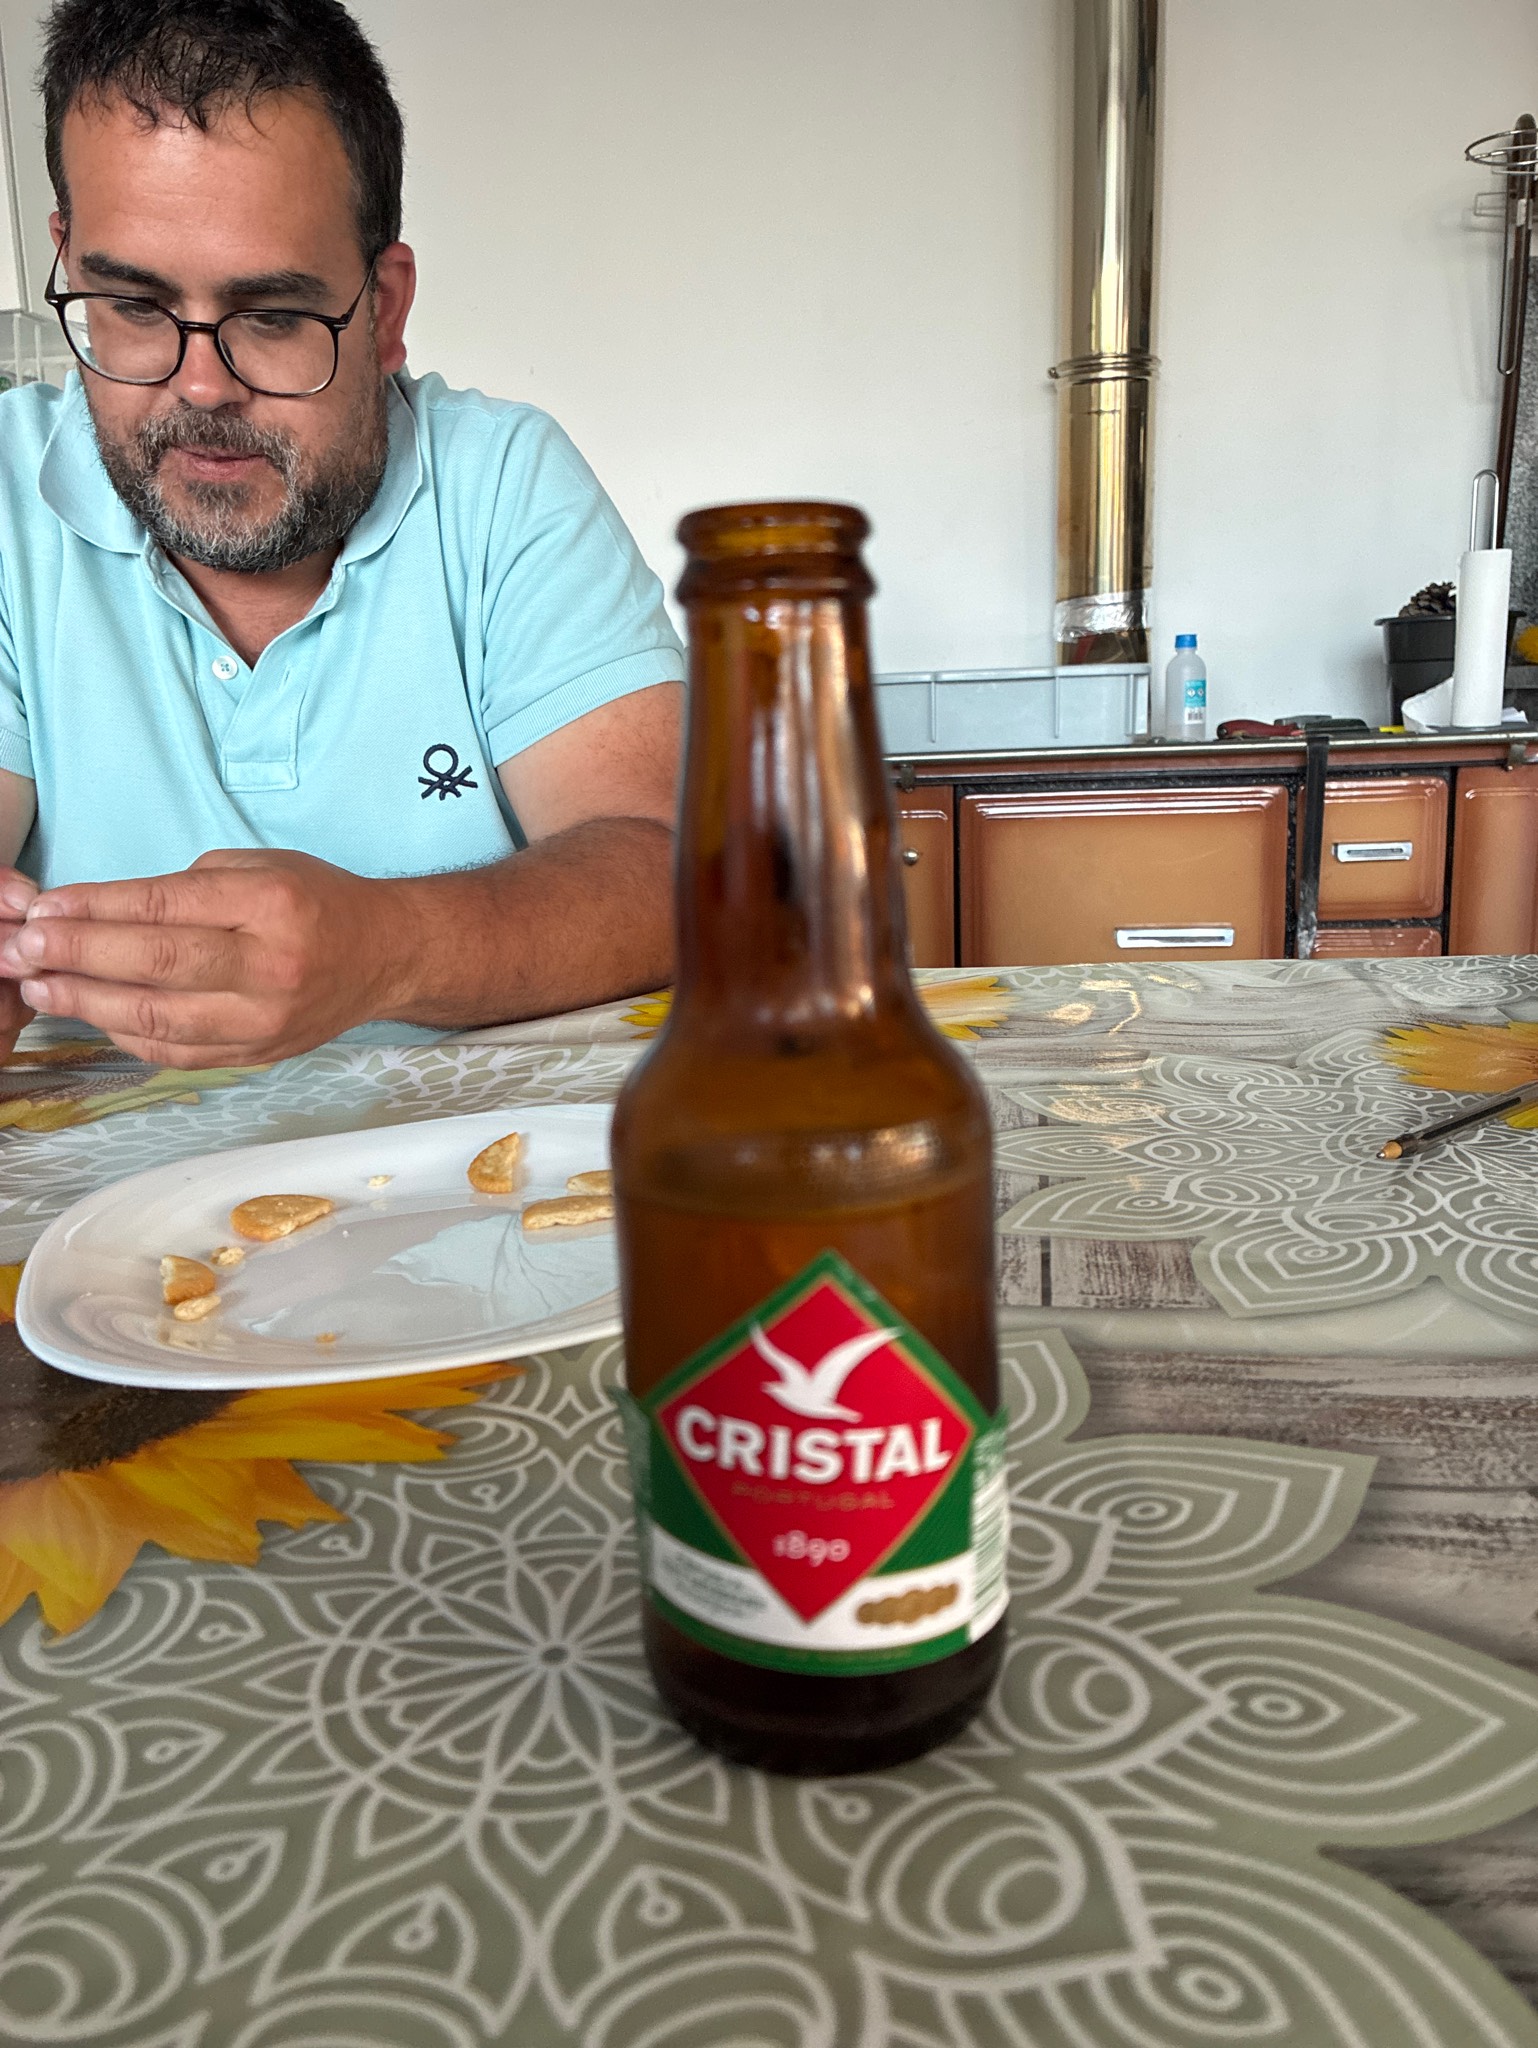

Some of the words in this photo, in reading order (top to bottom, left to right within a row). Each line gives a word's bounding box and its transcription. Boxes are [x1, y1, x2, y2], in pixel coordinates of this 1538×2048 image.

[676, 1405, 951, 1484] CRISTAL
[731, 1481, 895, 1511] PORTUGAL
[771, 1529, 851, 1567] 1890
